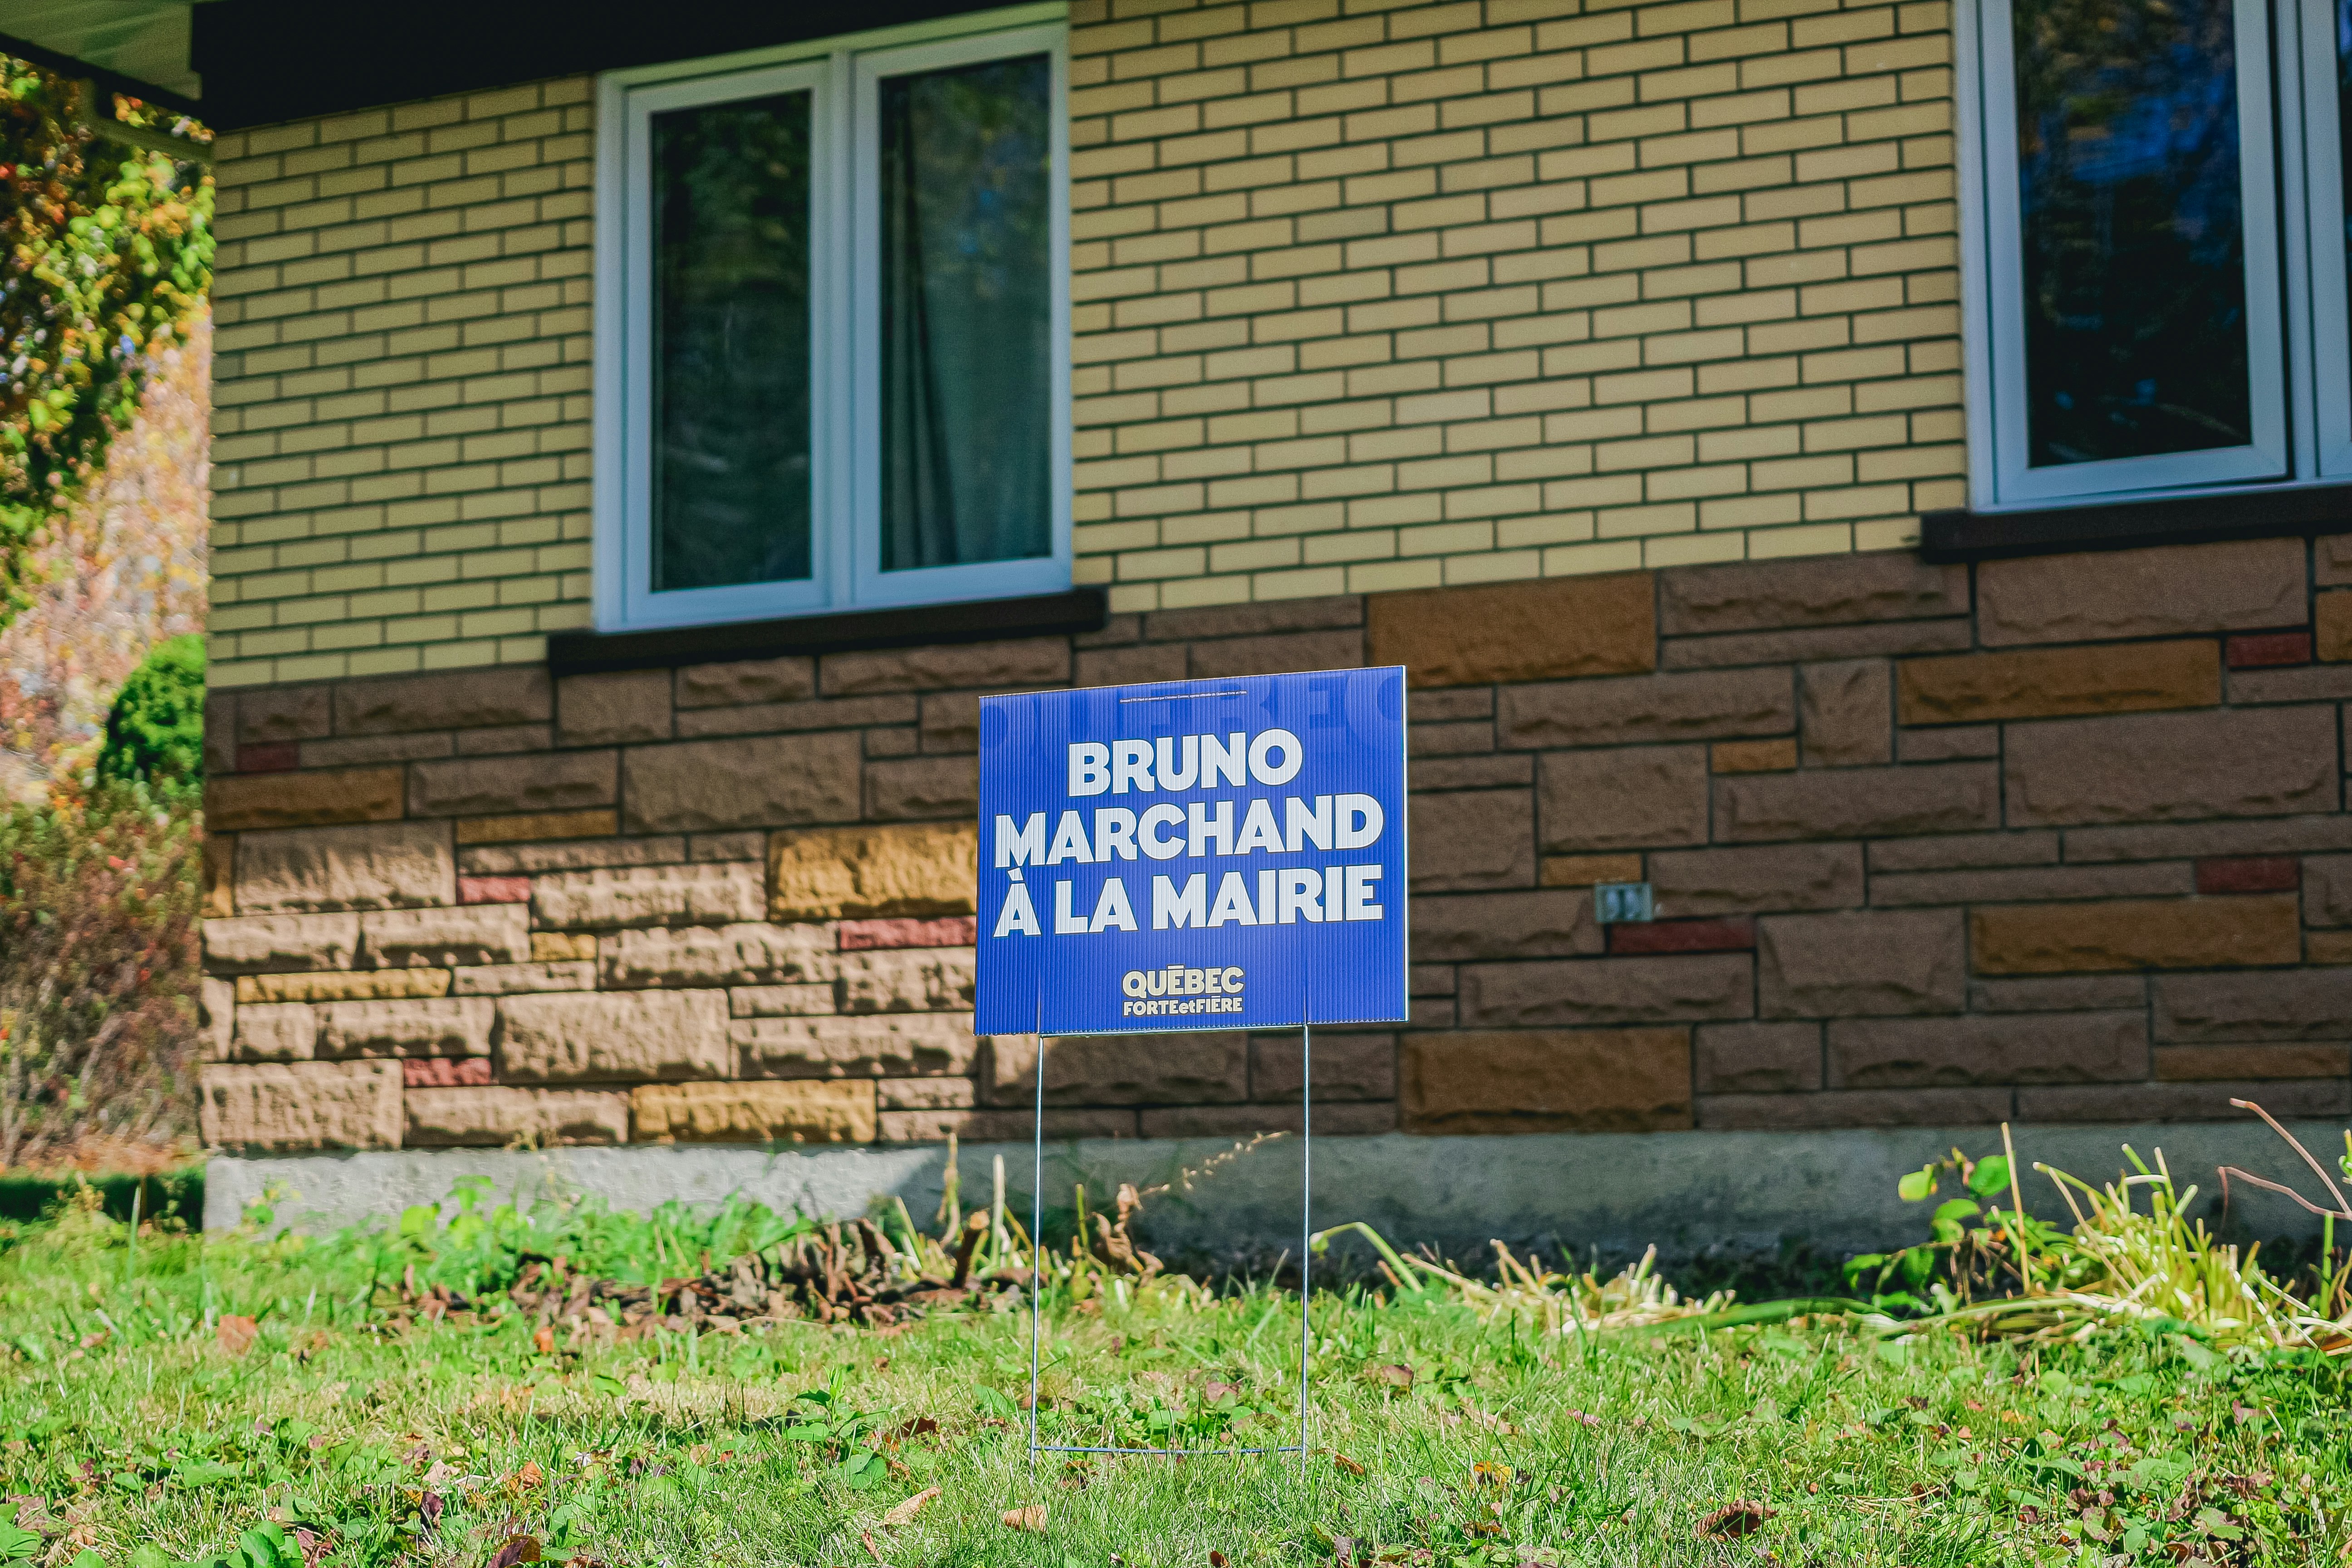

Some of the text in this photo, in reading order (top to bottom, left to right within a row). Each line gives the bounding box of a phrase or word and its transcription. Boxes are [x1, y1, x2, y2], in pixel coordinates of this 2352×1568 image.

[1068, 729, 1303, 797] BRUNO
[995, 794, 1383, 868] MARCHAND
[993, 864, 1383, 937] À LA MAIRIE
